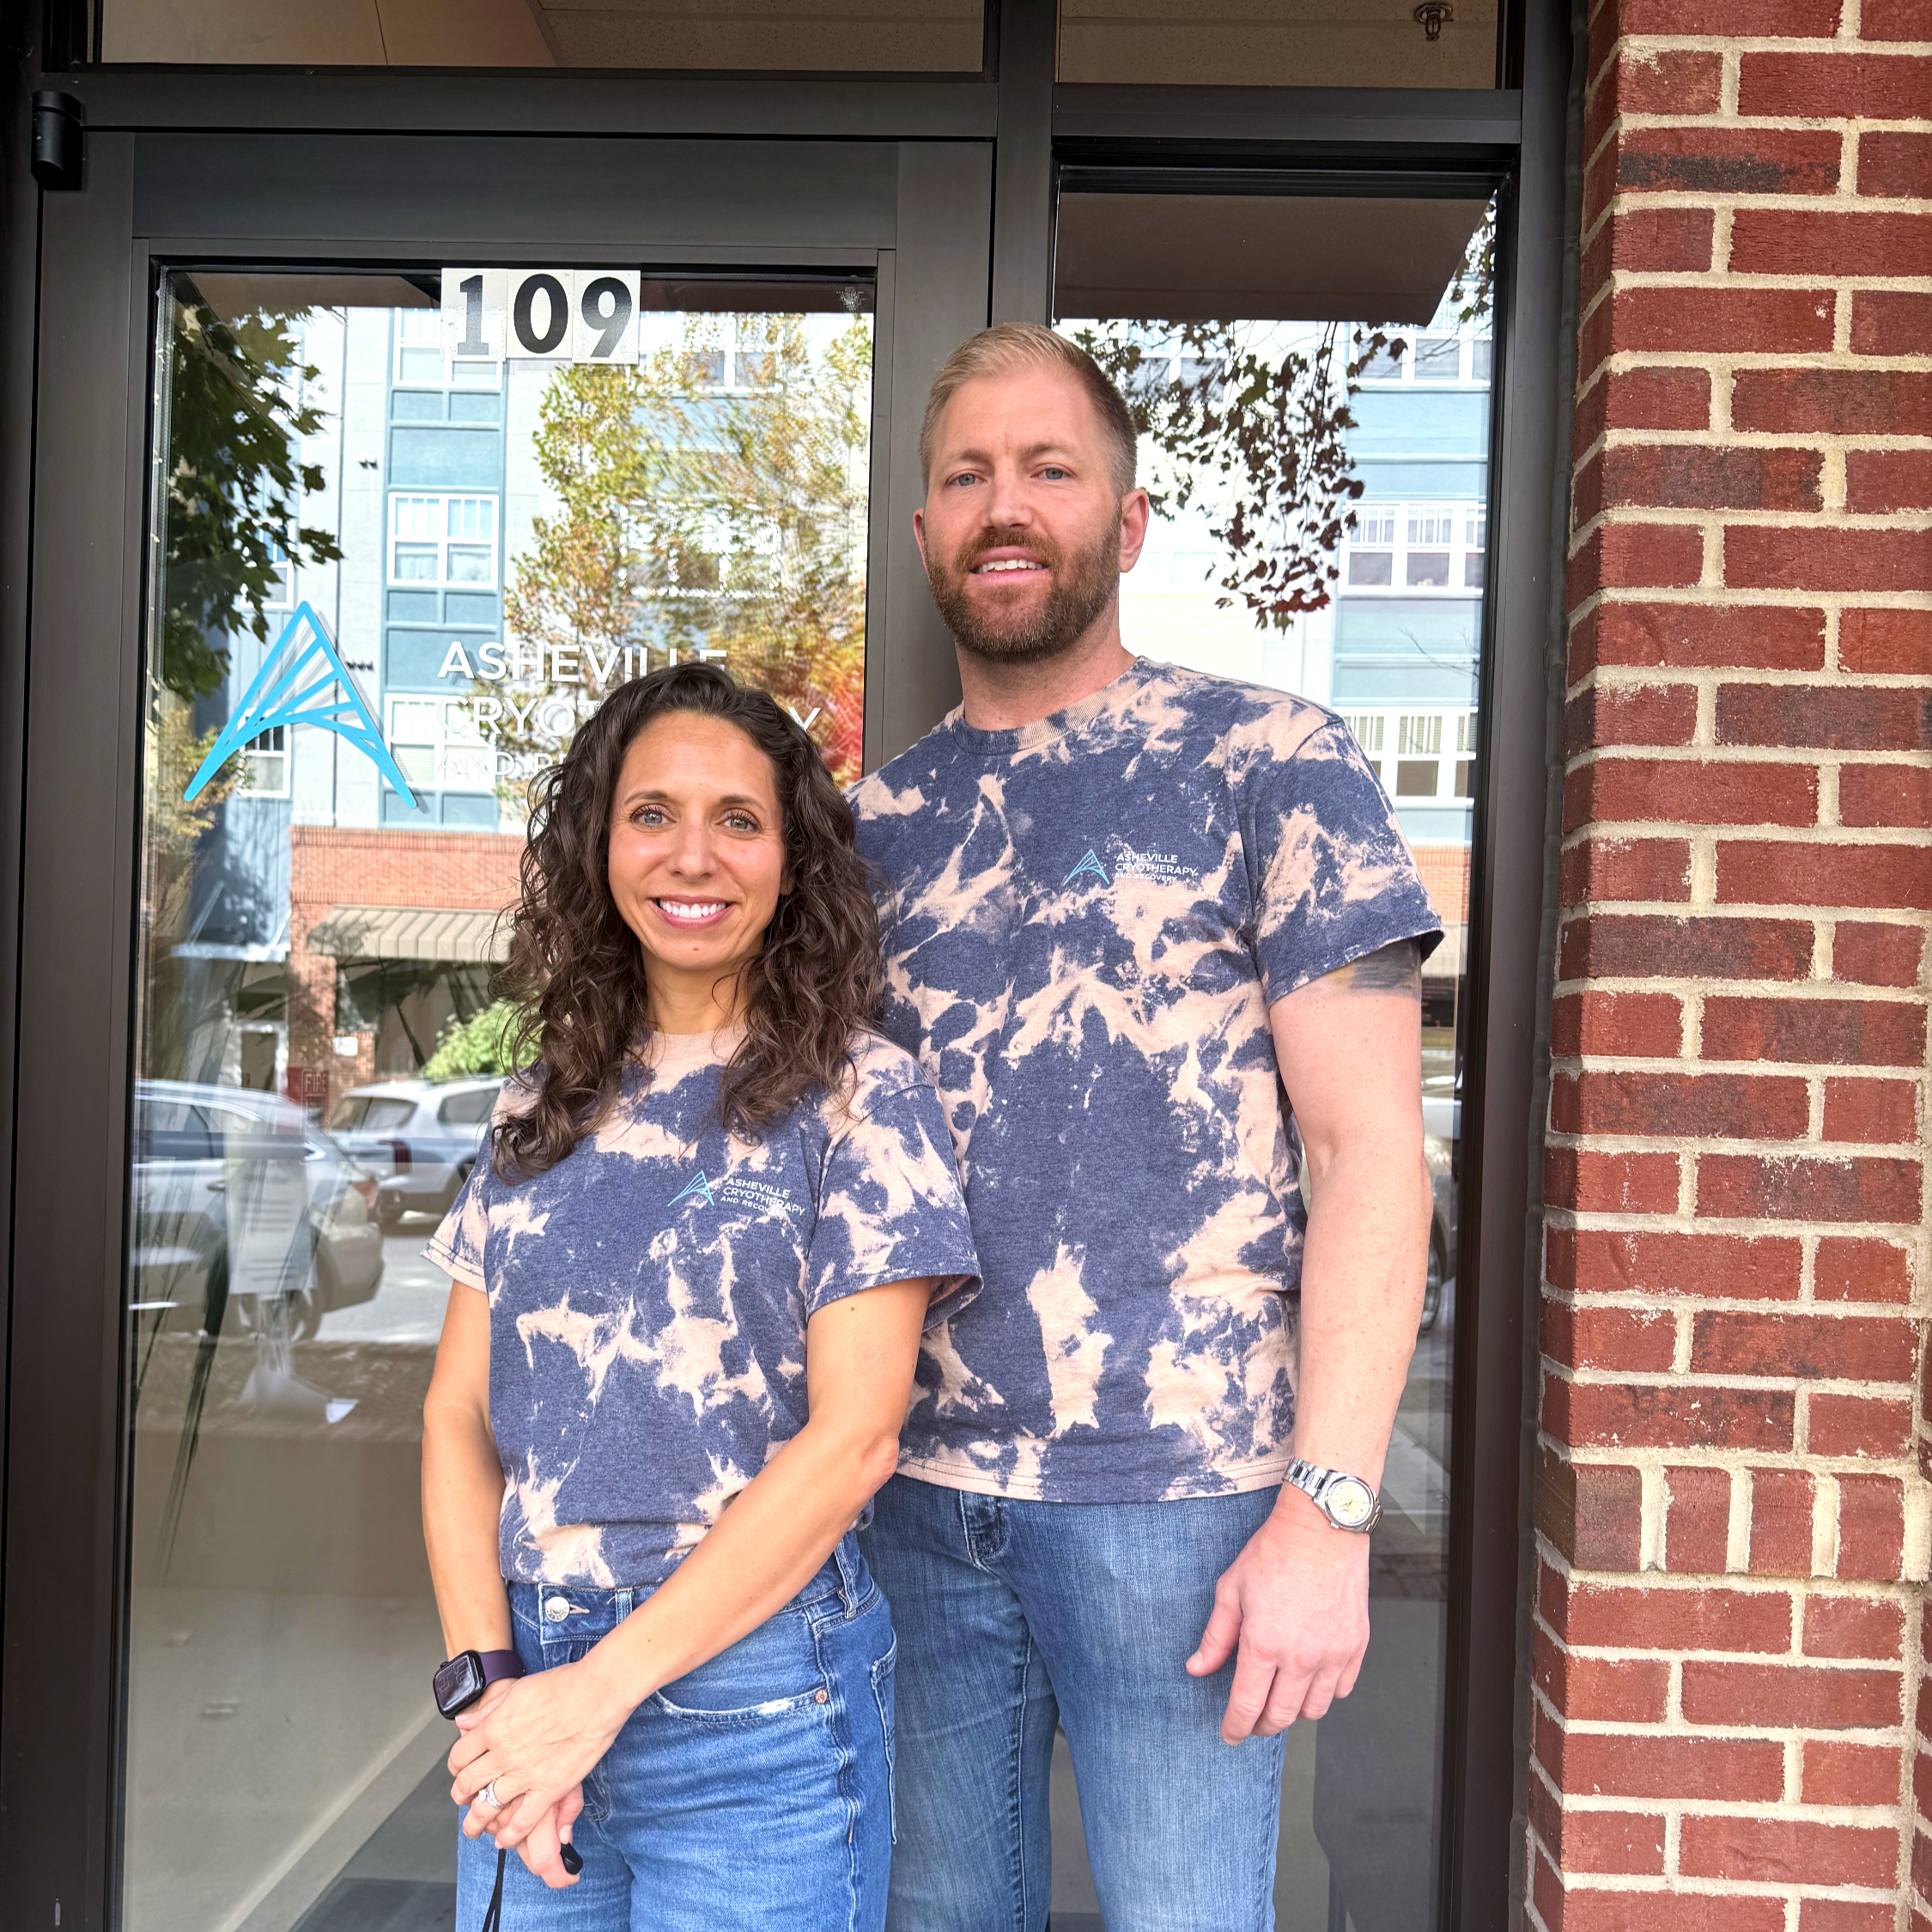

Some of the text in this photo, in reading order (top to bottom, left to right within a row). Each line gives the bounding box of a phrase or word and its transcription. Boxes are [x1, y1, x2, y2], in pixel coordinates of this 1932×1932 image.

[457, 272, 633, 359] 109
[437, 641, 727, 684] ASHEVIL
[1116, 853, 1178, 863] ASHEVILLE
[1115, 863, 1197, 877] CRYOTHERAPY
[1134, 873, 1177, 882] RECOVERY
[726, 1177, 791, 1200] ASHEVILLE
[723, 1188, 805, 1216] CRYOTHERAPY
